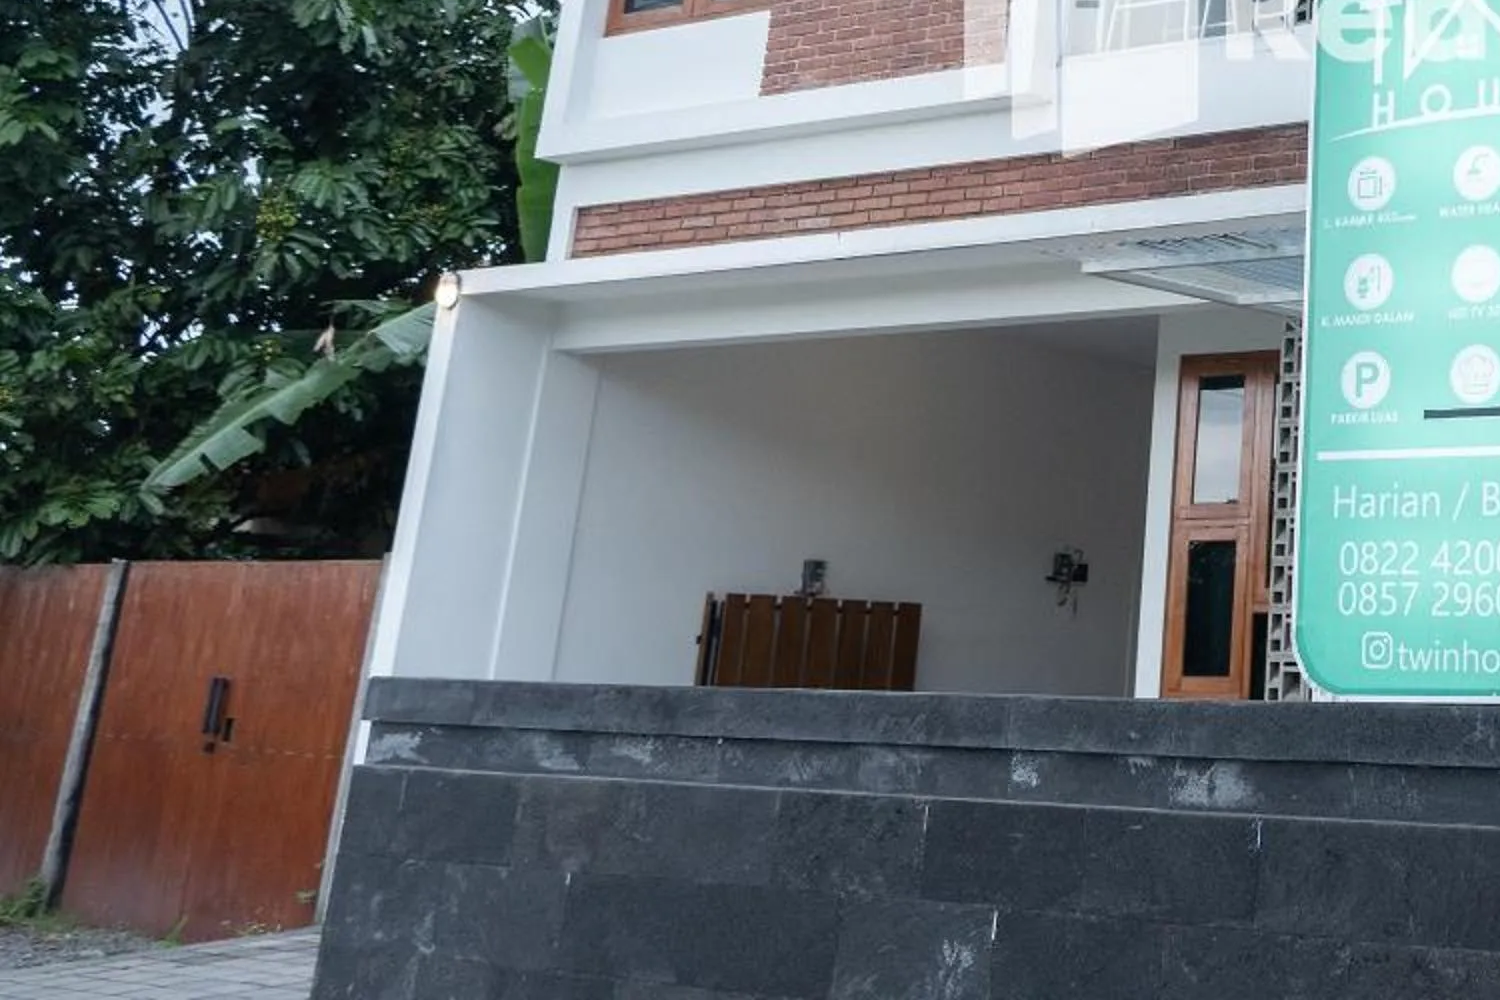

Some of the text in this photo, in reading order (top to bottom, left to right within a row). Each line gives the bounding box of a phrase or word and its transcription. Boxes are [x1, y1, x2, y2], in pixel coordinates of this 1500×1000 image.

[1438, 202, 1475, 218] WATER
[1355, 361, 1380, 399] P
[1332, 482, 1441, 520] Harian
[1452, 482, 1471, 521] /
[1339, 540, 1419, 576] 0822
[1337, 581, 1418, 617] 0857
